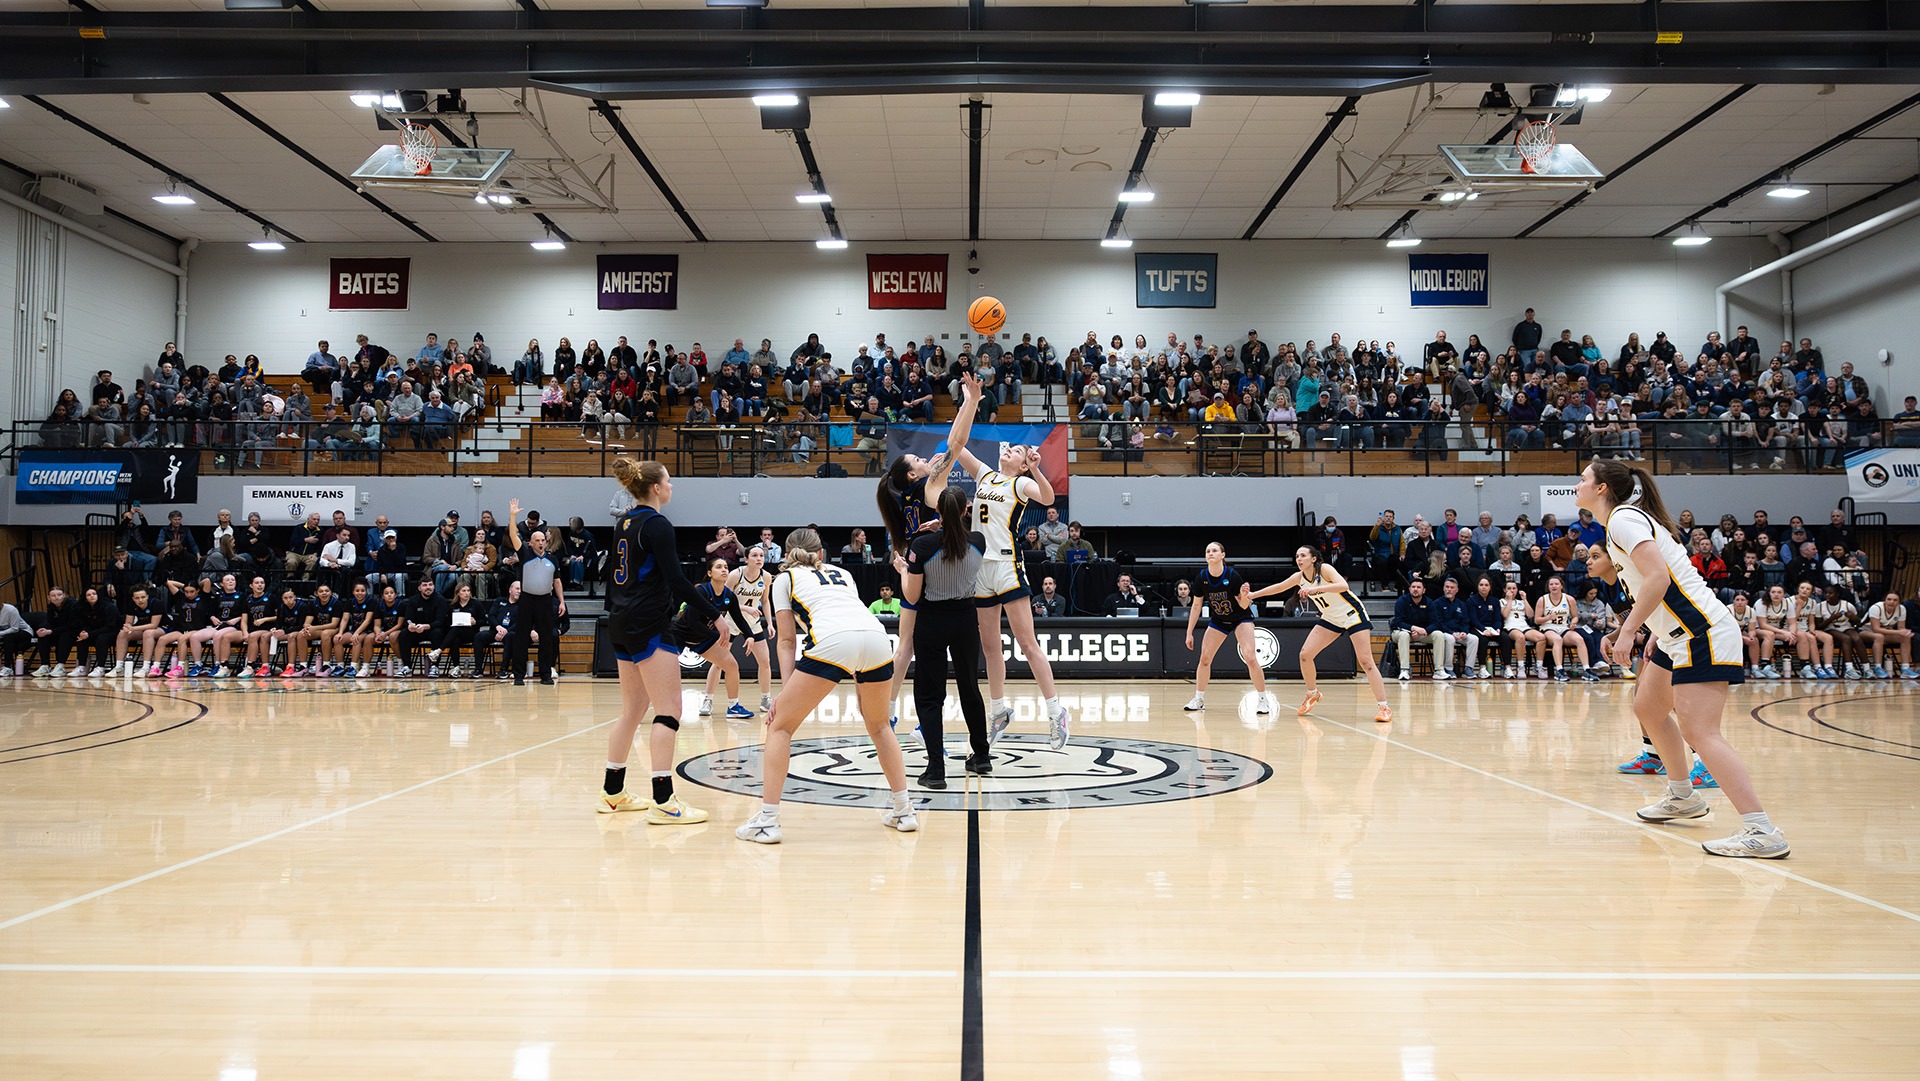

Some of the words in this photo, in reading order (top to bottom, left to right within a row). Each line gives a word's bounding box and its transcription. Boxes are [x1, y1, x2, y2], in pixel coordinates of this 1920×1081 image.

[339, 272, 399, 294] BATES
[601, 271, 673, 293] AMHERST
[872, 271, 943, 293] WESLEYAN
[1145, 270, 1207, 292] TUFTS
[1411, 269, 1486, 292] MIDDLEBURY
[29, 470, 116, 485] CHAMPIONS
[1893, 464, 1920, 478] UNI
[977, 488, 1005, 502] uskies
[980, 503, 989, 524] 2
[614, 538, 628, 585] 3
[812, 569, 847, 587] 12
[744, 598, 753, 607] 4
[1211, 600, 1232, 615] 33
[1315, 596, 1329, 608] 11
[186, 608, 192, 622] 1
[222, 608, 230, 619] 9
